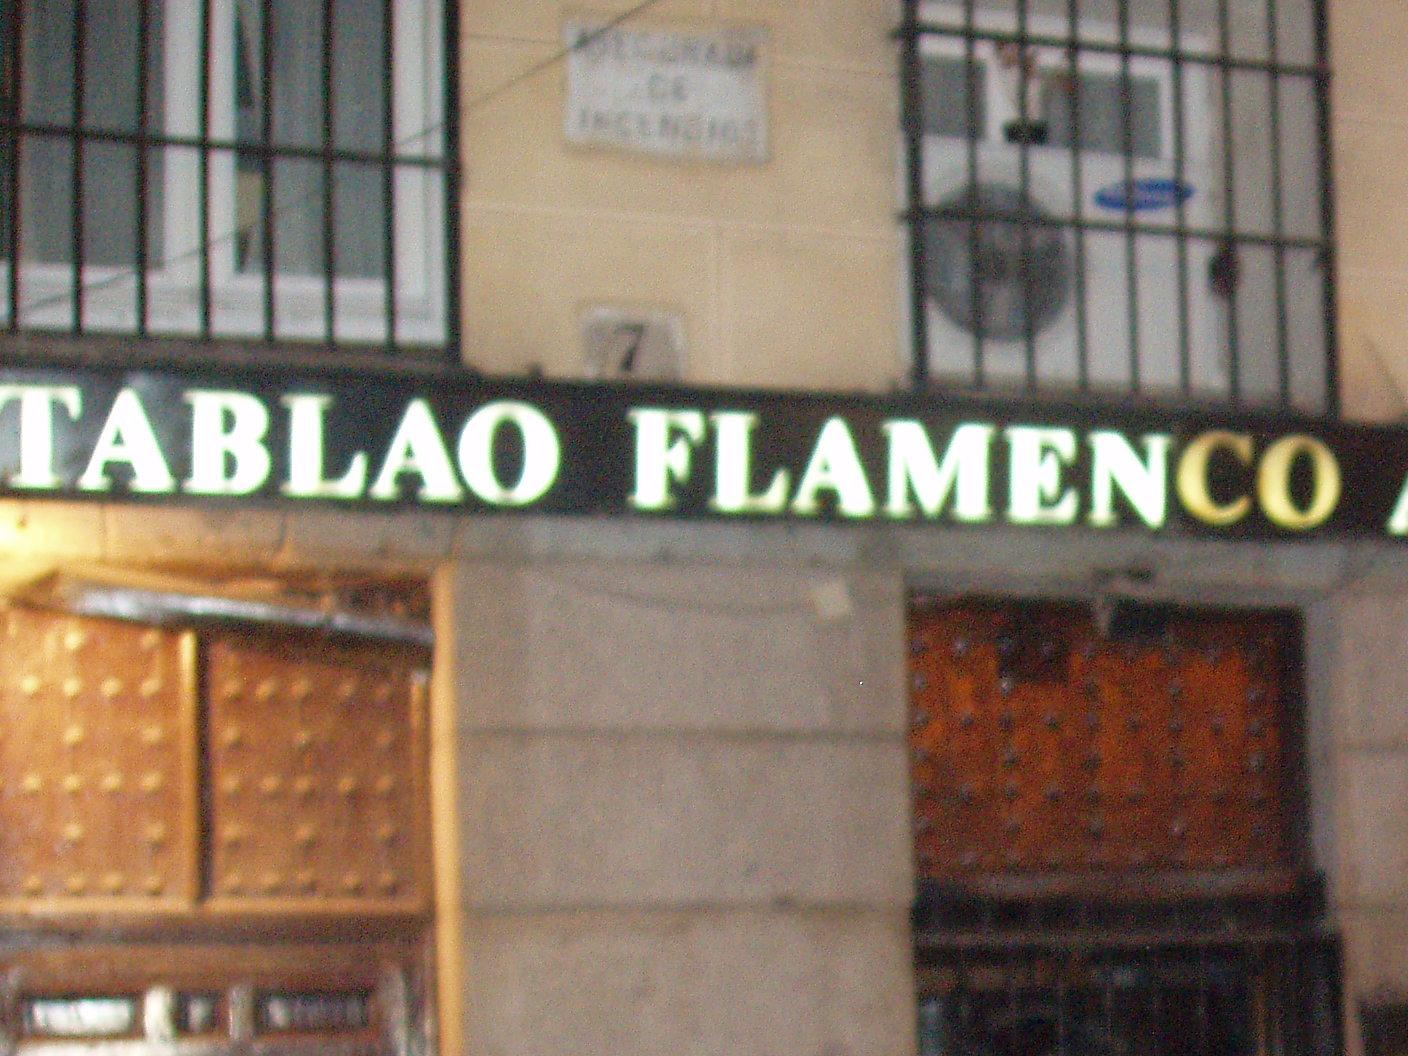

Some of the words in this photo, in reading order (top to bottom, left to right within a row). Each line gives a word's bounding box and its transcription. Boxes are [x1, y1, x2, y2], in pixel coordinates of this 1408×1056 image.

[614, 321, 648, 372] 7
[0, 381, 563, 507] TABLAO
[627, 406, 1343, 533] FLAMENCO
